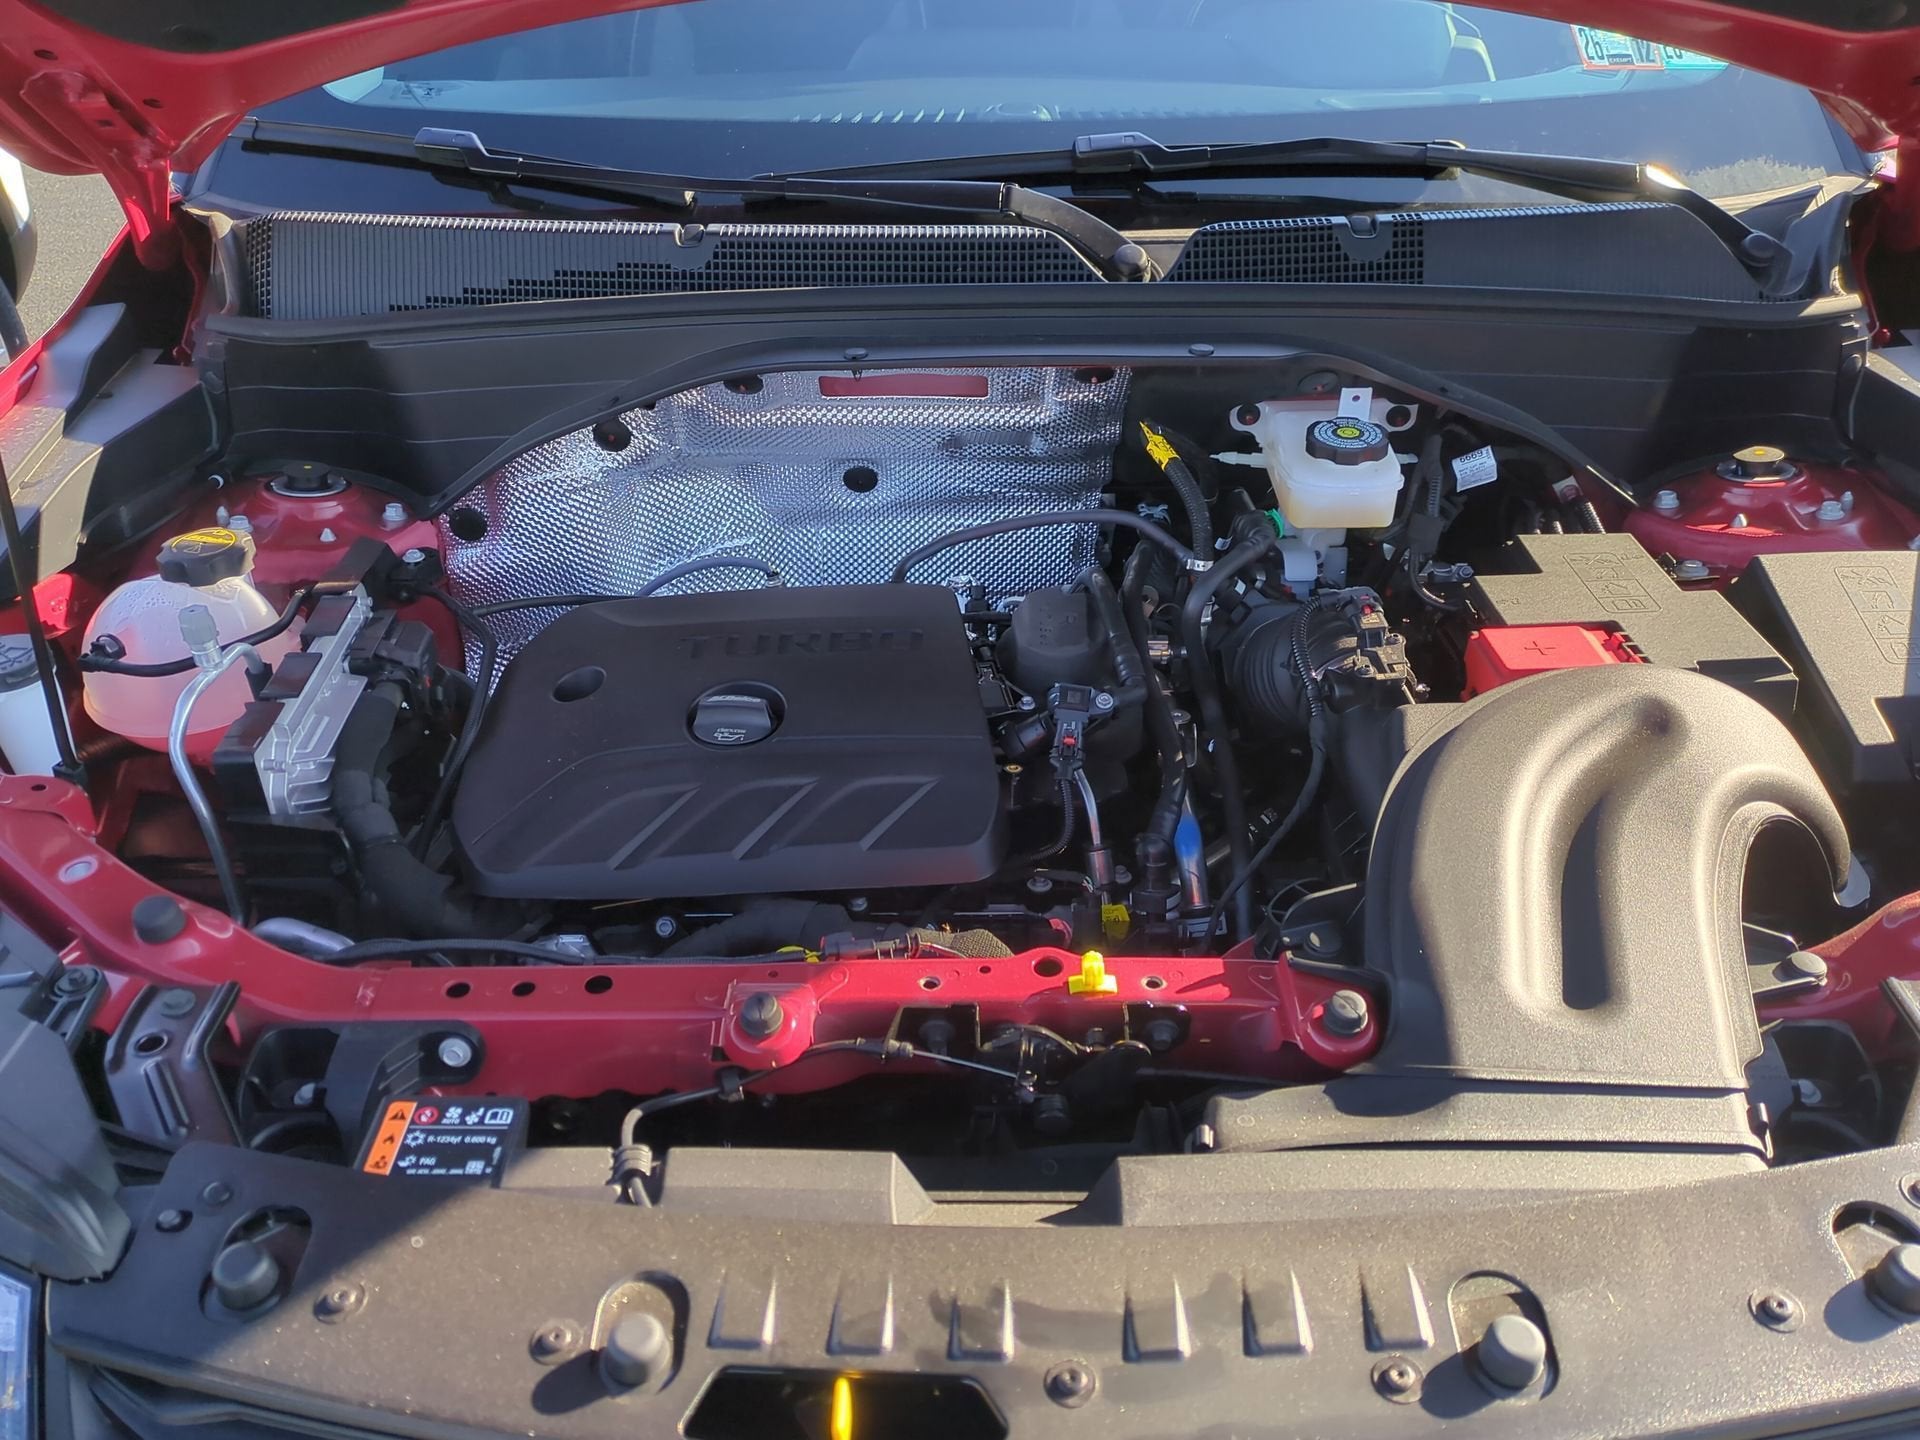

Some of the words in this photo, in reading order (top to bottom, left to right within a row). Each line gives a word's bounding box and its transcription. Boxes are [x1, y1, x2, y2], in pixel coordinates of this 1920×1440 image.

[1578, 27, 1605, 61] 26
[678, 628, 925, 659] TURBO
[487, 1136, 497, 1145] kg
[419, 1157, 436, 1165] PAG
